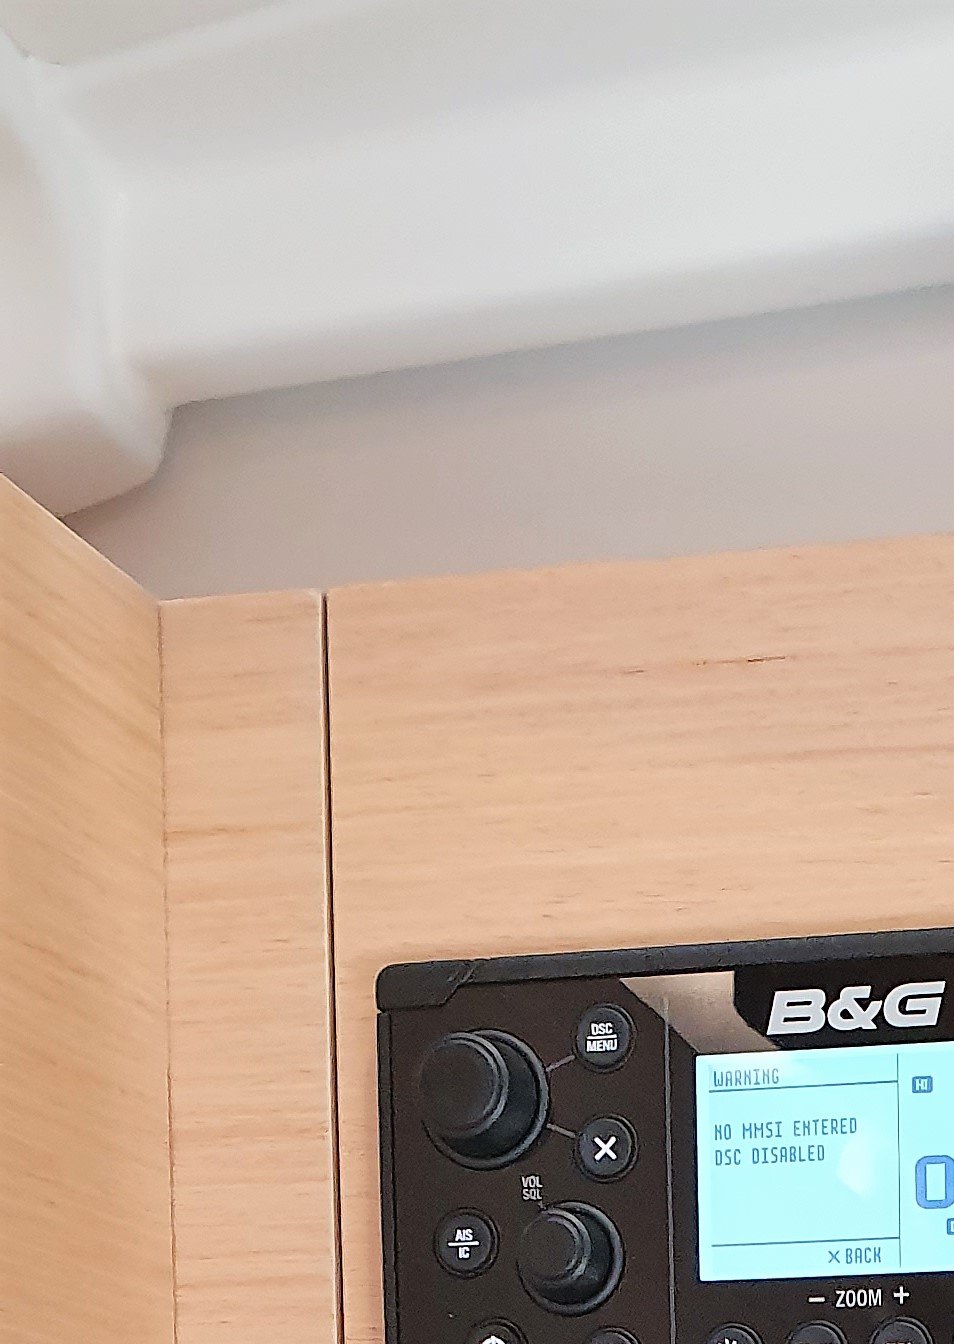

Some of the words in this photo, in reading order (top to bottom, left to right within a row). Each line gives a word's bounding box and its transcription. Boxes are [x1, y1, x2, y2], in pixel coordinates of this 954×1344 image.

[767, 981, 946, 1036] B&G
[590, 1022, 613, 1036] DSC
[586, 1038, 618, 1053] MENU
[713, 1068, 780, 1087] WARNING
[714, 1123, 732, 1141] NO
[742, 1120, 783, 1139] MMSI
[793, 1117, 857, 1137] ENTERED
[715, 1148, 741, 1166] DSC
[752, 1144, 825, 1164] DISABLED
[521, 1175, 543, 1188] VOL
[522, 1188, 543, 1201] SQL
[455, 1229, 473, 1242] AIS
[458, 1246, 470, 1259] IC
[845, 1246, 882, 1264] BACK
[835, 1288, 882, 1309] ZOOM
